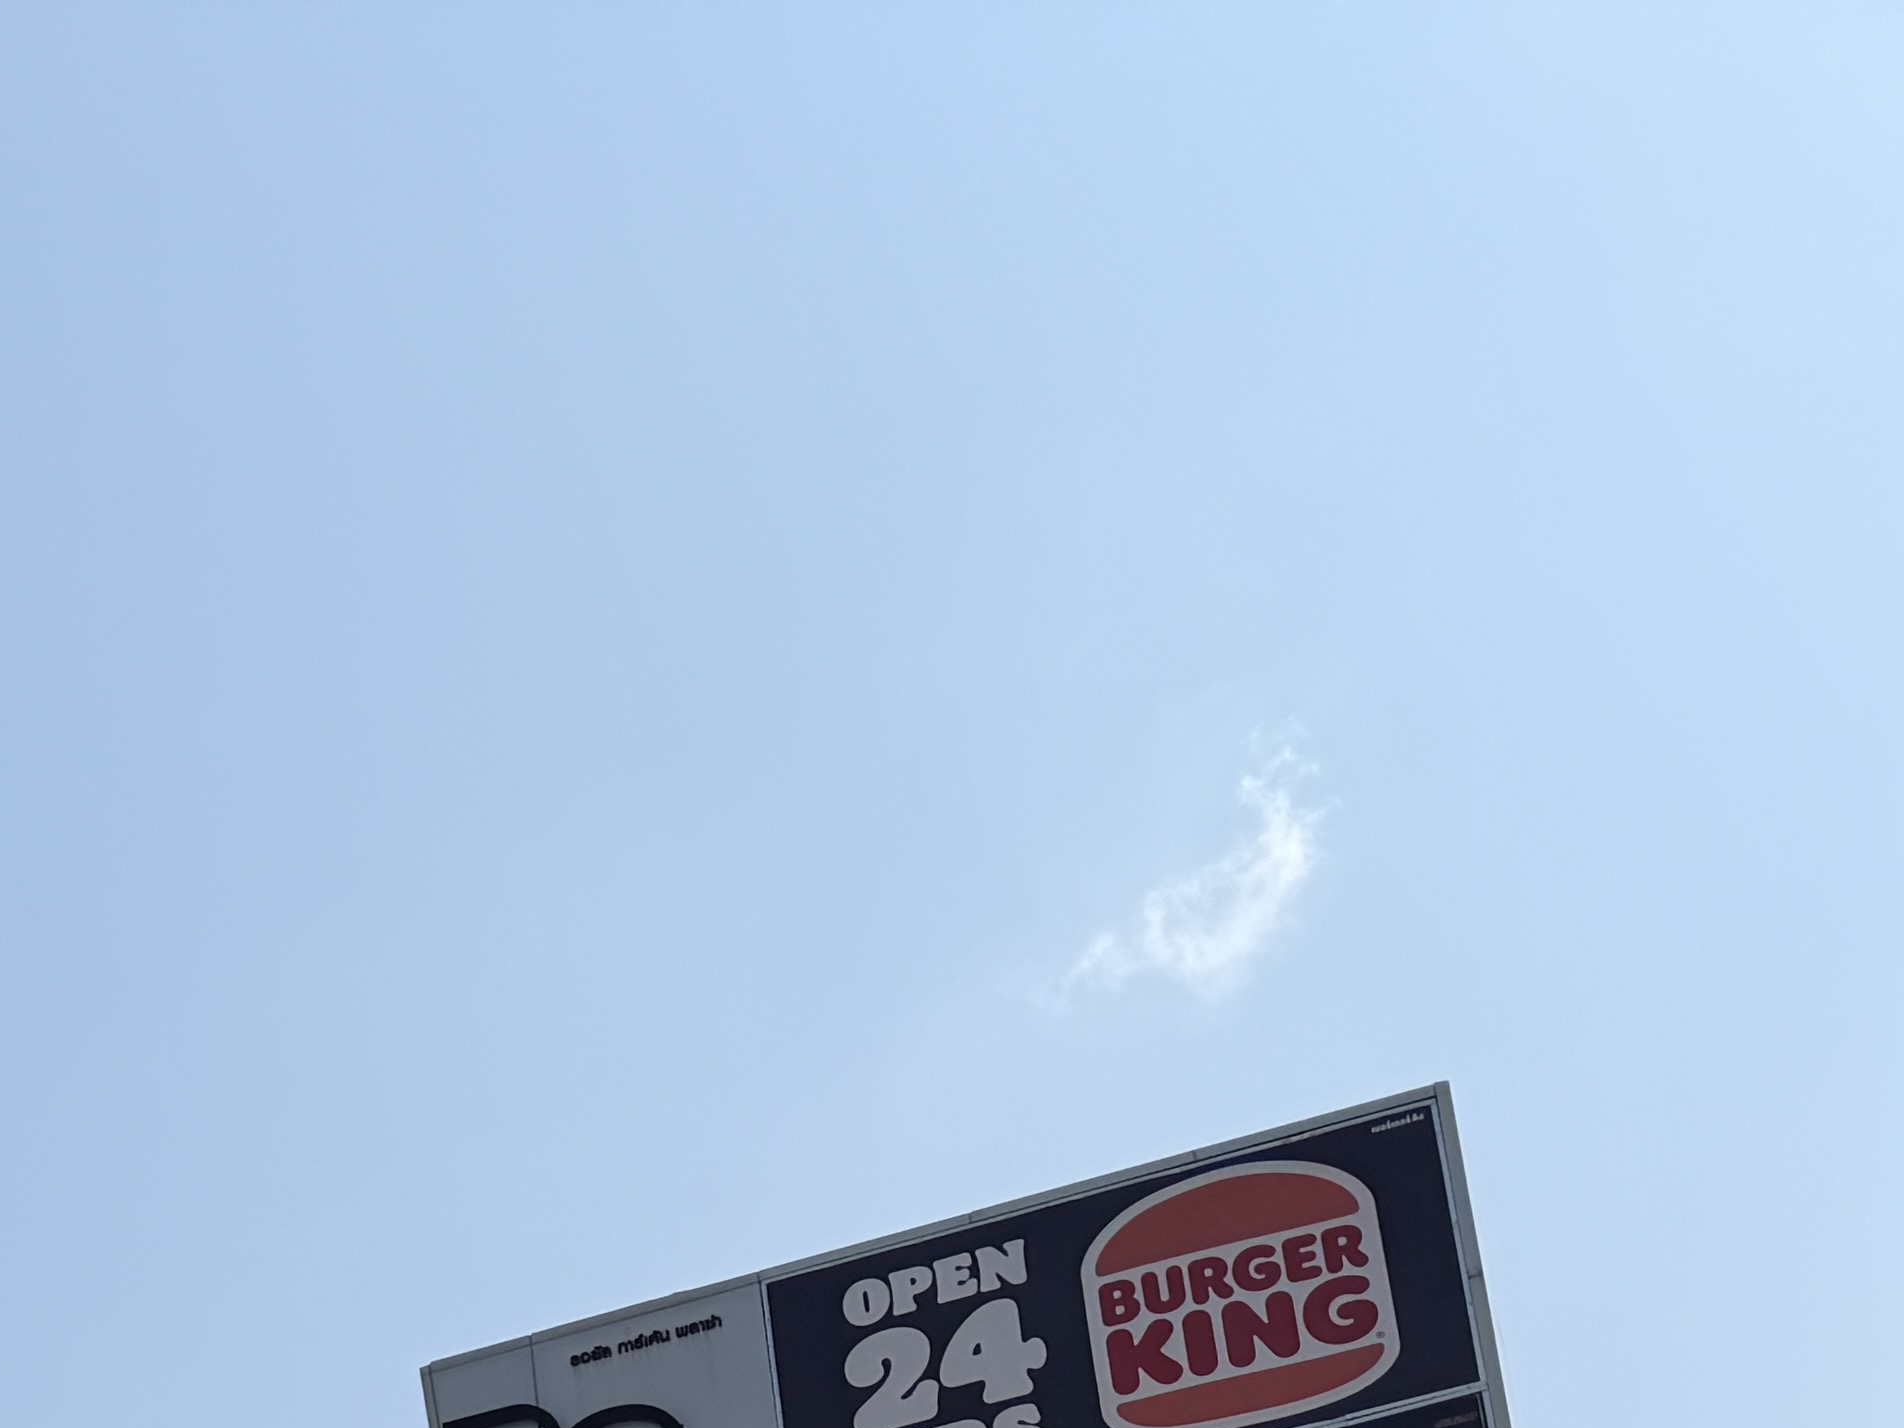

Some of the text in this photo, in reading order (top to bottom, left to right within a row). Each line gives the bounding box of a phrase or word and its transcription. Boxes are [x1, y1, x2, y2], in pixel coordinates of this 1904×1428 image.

[842, 1237, 1029, 1328] OPEN
[1100, 1224, 1371, 1328] BURGER
[1104, 1274, 1379, 1396] KING
